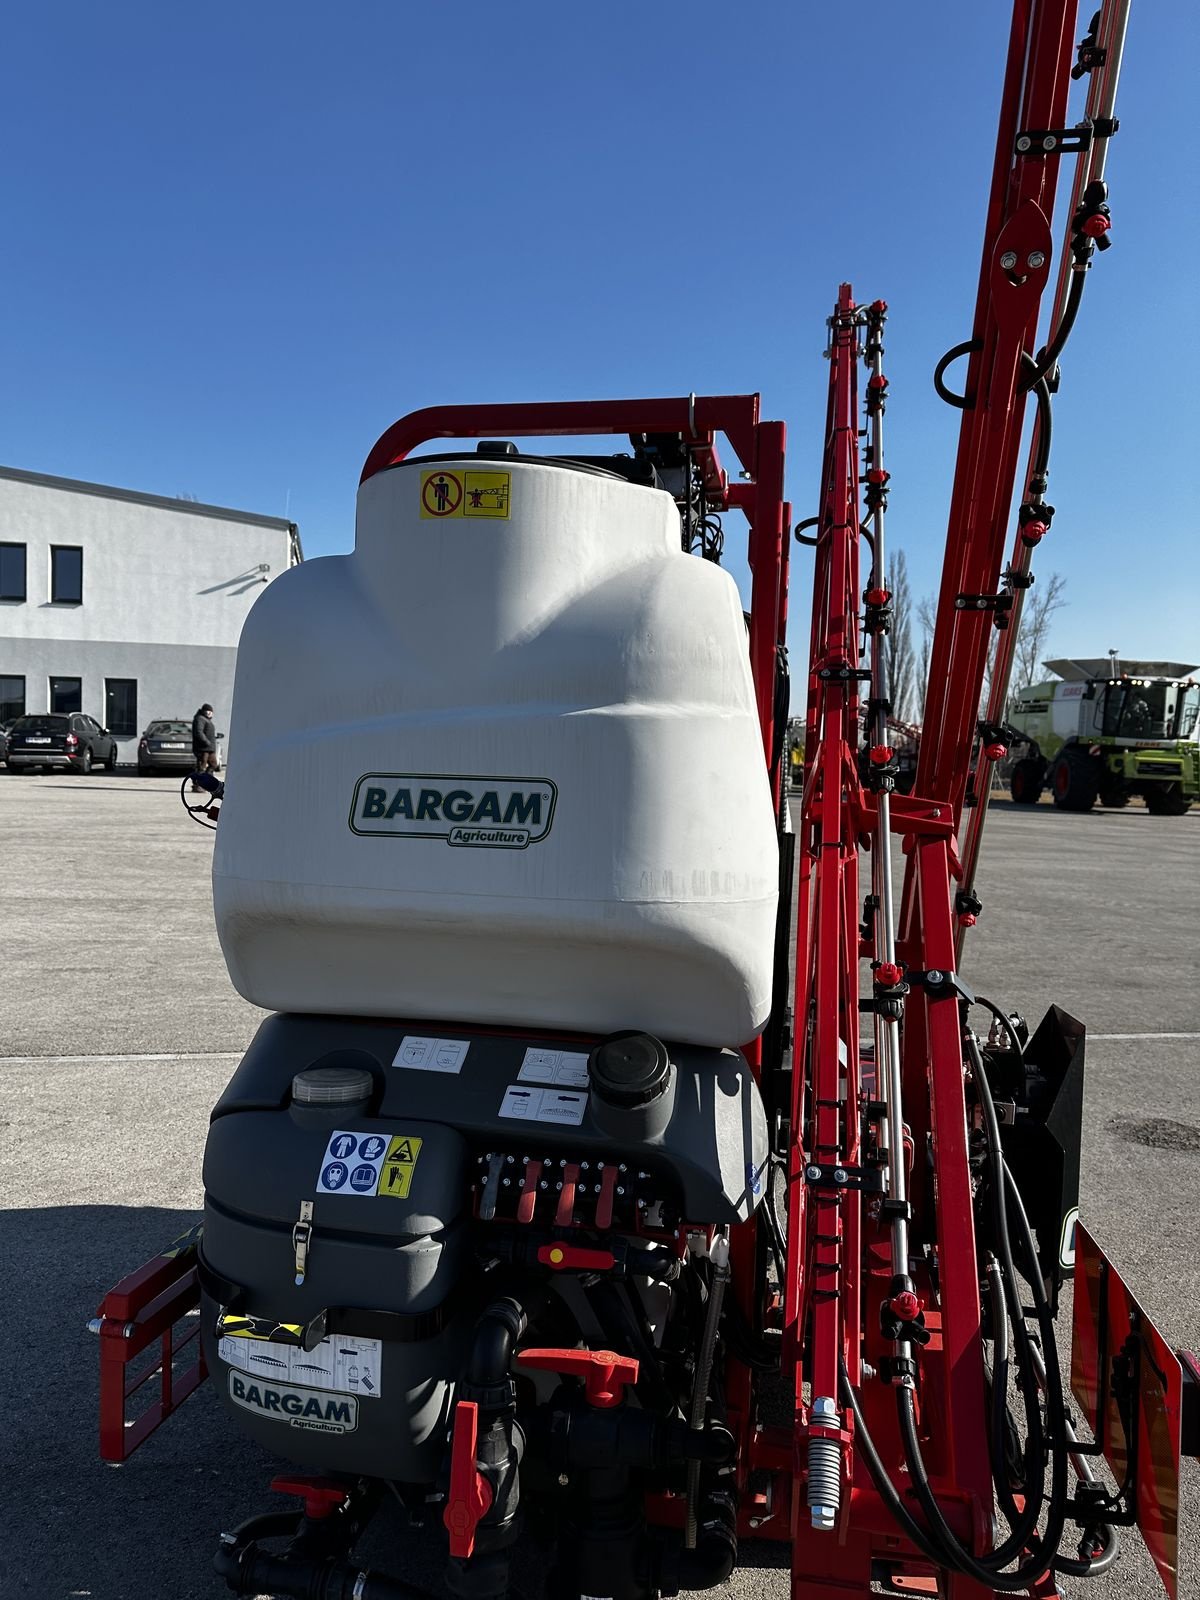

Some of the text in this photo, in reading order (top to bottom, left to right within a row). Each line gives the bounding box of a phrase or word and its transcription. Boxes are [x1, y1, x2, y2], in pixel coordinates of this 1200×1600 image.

[361, 786, 542, 825] BARGAM
[453, 829, 526, 844] Agriculture
[232, 1376, 352, 1424] BARGAM
[292, 1419, 343, 1433] Agriculture
